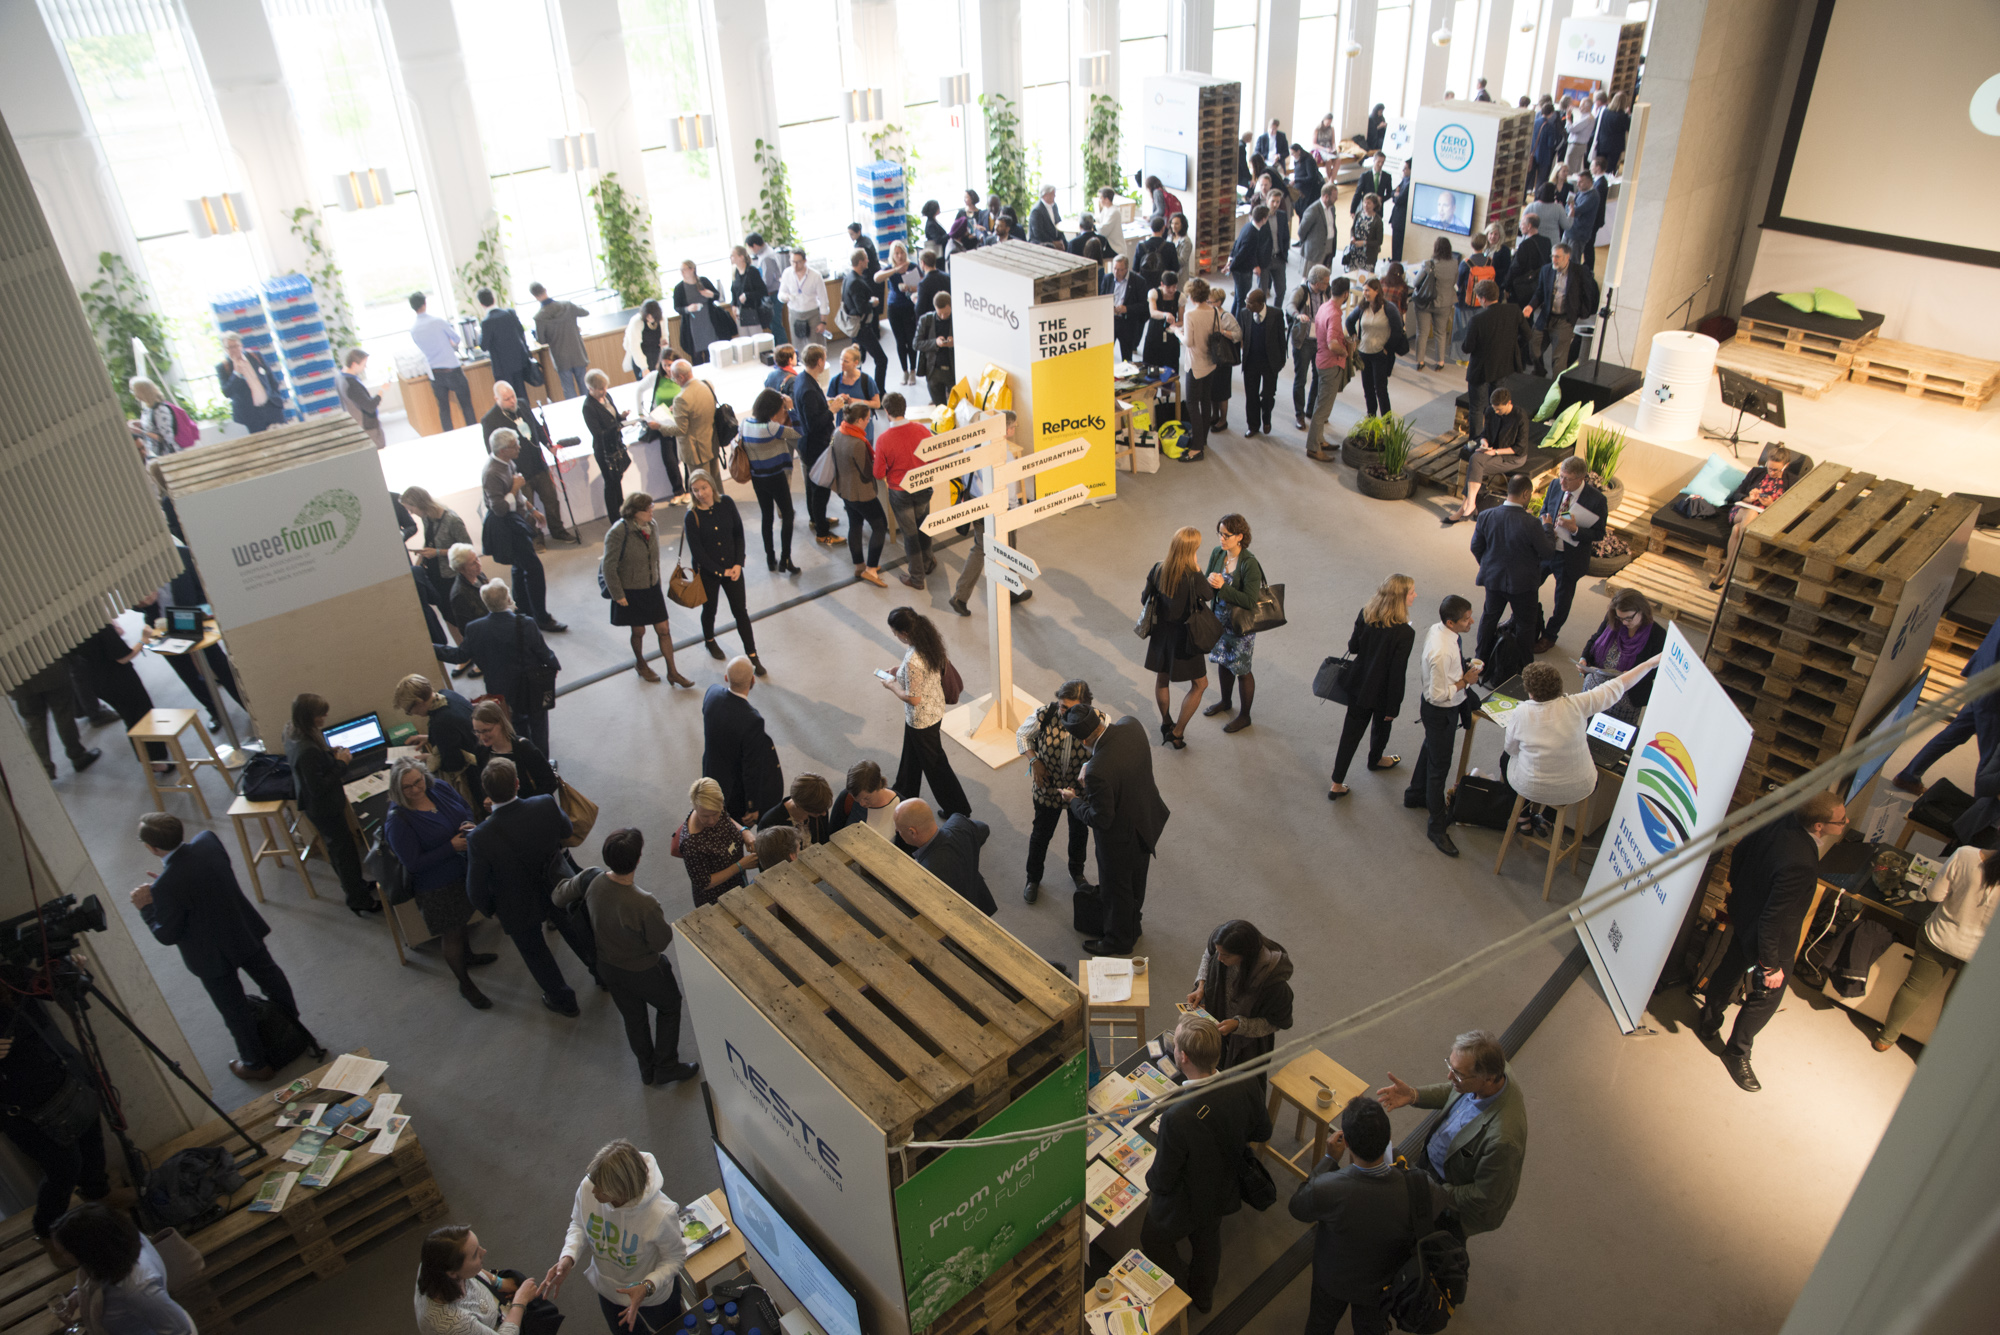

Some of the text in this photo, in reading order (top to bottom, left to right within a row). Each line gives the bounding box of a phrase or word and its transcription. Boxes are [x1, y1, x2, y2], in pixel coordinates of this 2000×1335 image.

[1577, 50, 1605, 65] FISU
[1440, 144, 1466, 156] WASTE
[1442, 134, 1467, 148] ZERO
[1440, 152, 1465, 162] SCOTLAND
[1039, 318, 1067, 332] THE
[1039, 327, 1091, 346] END OF
[1040, 341, 1087, 358] TRASH
[922, 428, 986, 454] LAKESIDE CHATS
[909, 456, 971, 482] OPPORTUNITIES
[1022, 446, 1084, 471] RESTAURANT HALL
[909, 476, 934, 489] STAGE
[1034, 498, 1067, 514] HELSINKI
[1067, 492, 1084, 502] HALL
[928, 503, 990, 529] FINLANDIA HALL
[231, 520, 338, 567] weeeforum
[993, 546, 1034, 574] TERRACE HALL
[1004, 575, 1019, 588] INFO
[1671, 642, 1684, 664] UN
[730, 1066, 843, 1193] The only way is forward
[929, 1185, 989, 1238] From
[996, 1129, 1063, 1185] waste
[963, 1165, 1035, 1231] to Fuel
[586, 1212, 639, 1255] EDU
